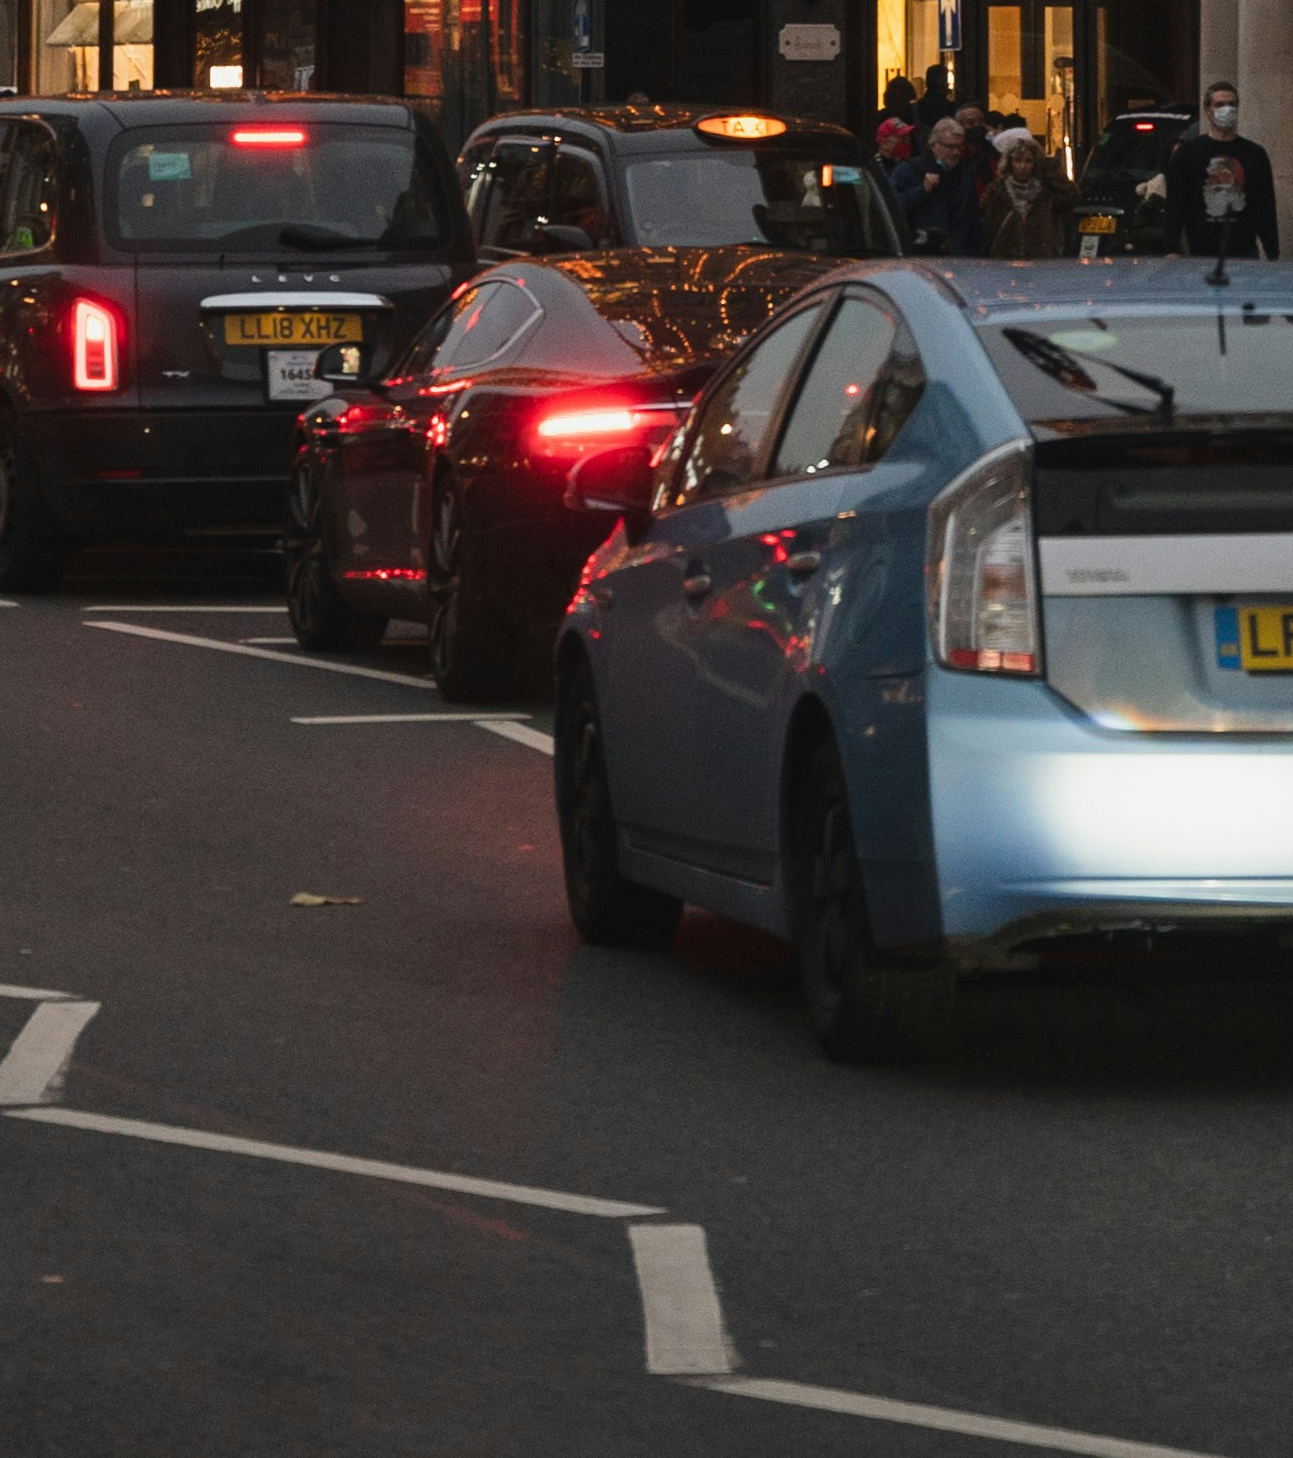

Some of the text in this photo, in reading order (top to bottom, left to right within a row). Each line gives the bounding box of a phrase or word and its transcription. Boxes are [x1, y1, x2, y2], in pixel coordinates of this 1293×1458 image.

[722, 119, 769, 134] TAXI
[240, 316, 348, 339] LL18 XHZ
[281, 369, 315, 380] 1645
